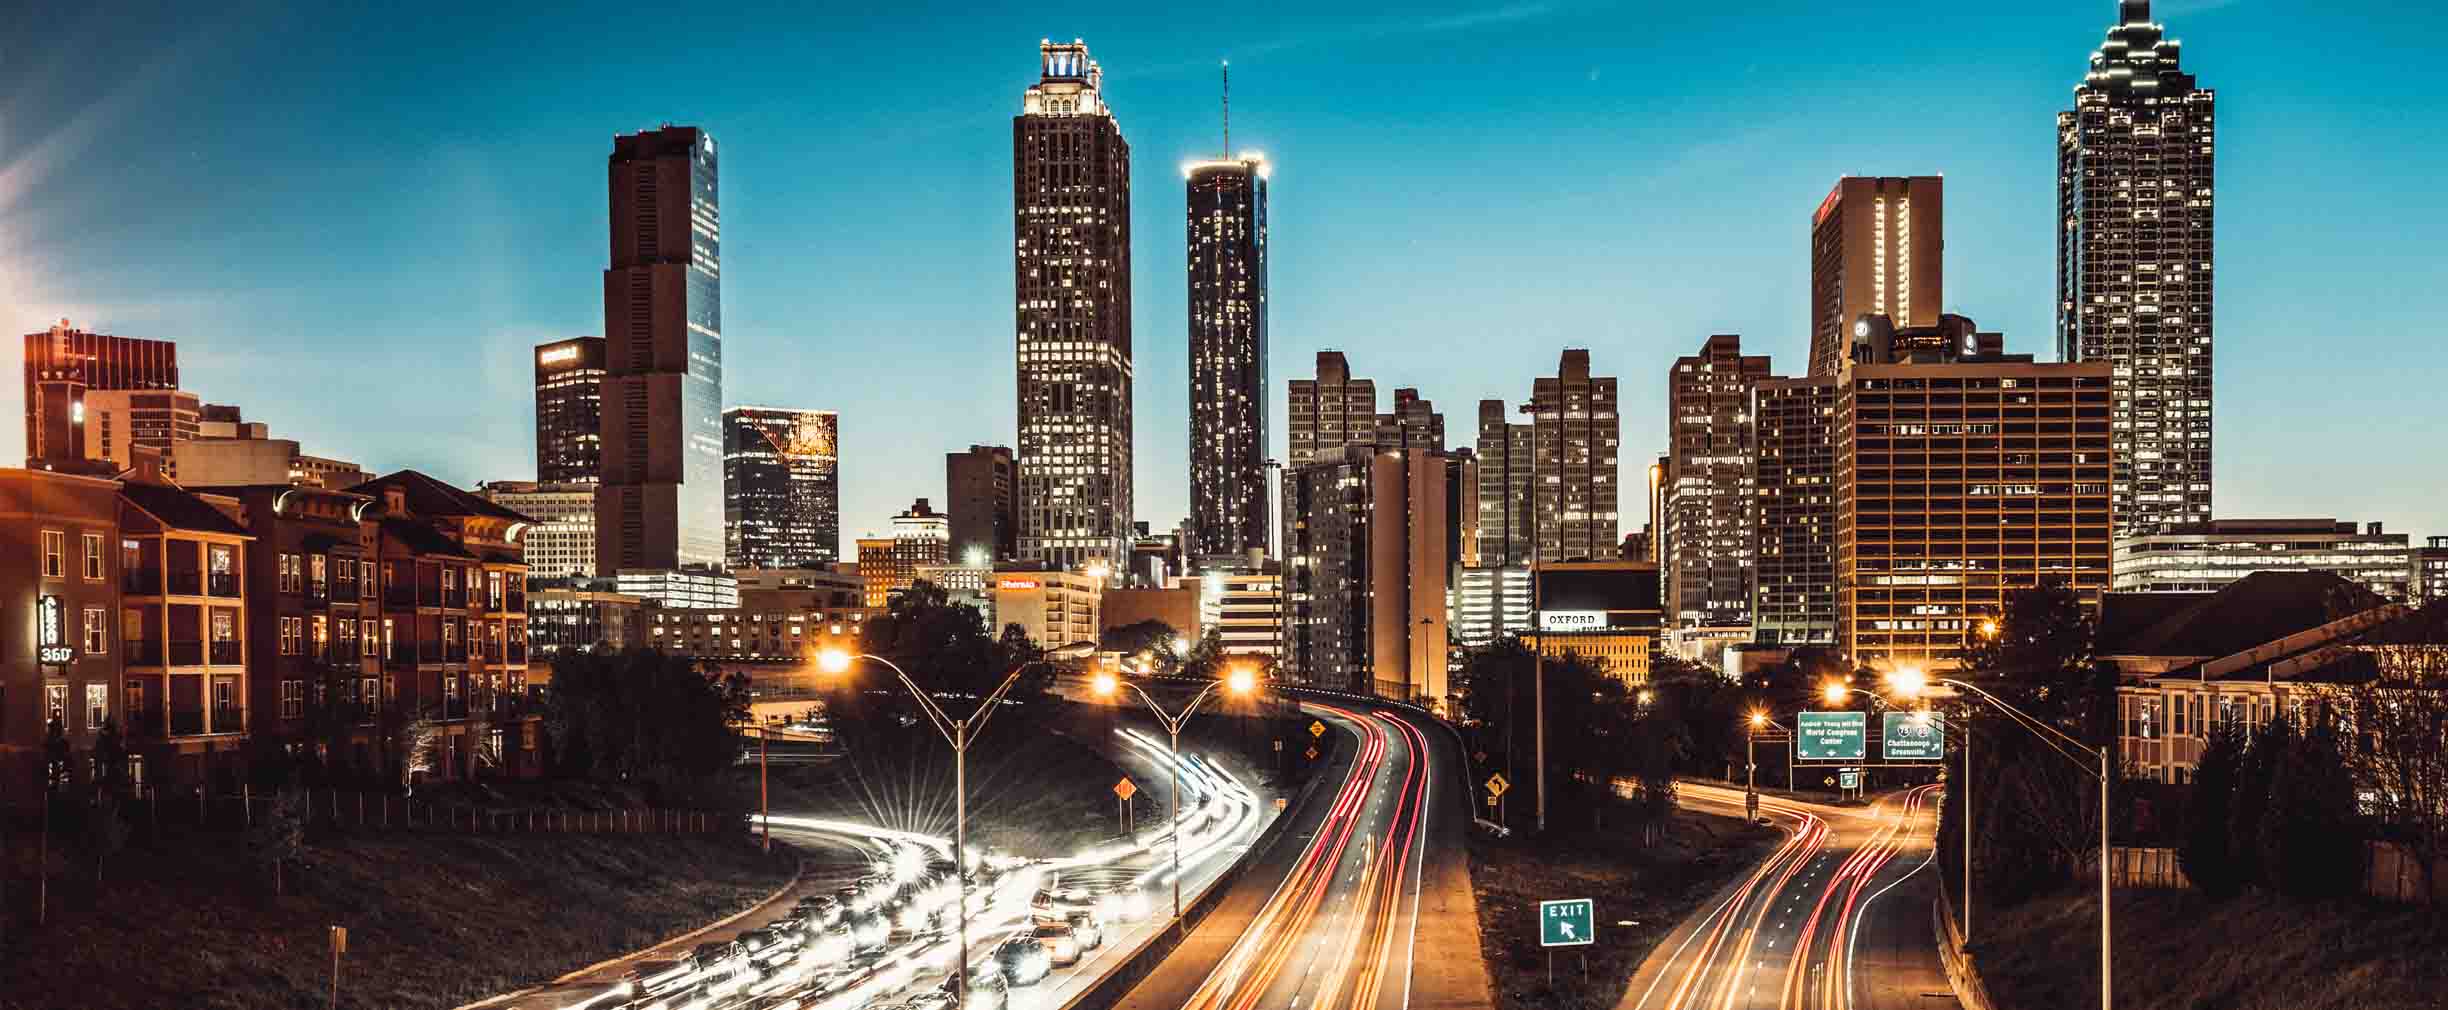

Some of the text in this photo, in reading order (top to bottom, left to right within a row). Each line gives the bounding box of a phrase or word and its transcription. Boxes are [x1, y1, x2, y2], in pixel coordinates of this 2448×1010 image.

[1549, 615, 1595, 624] OXFORD
[1888, 739, 1930, 748] Chattanooga
[1549, 904, 1584, 917] EXIT
